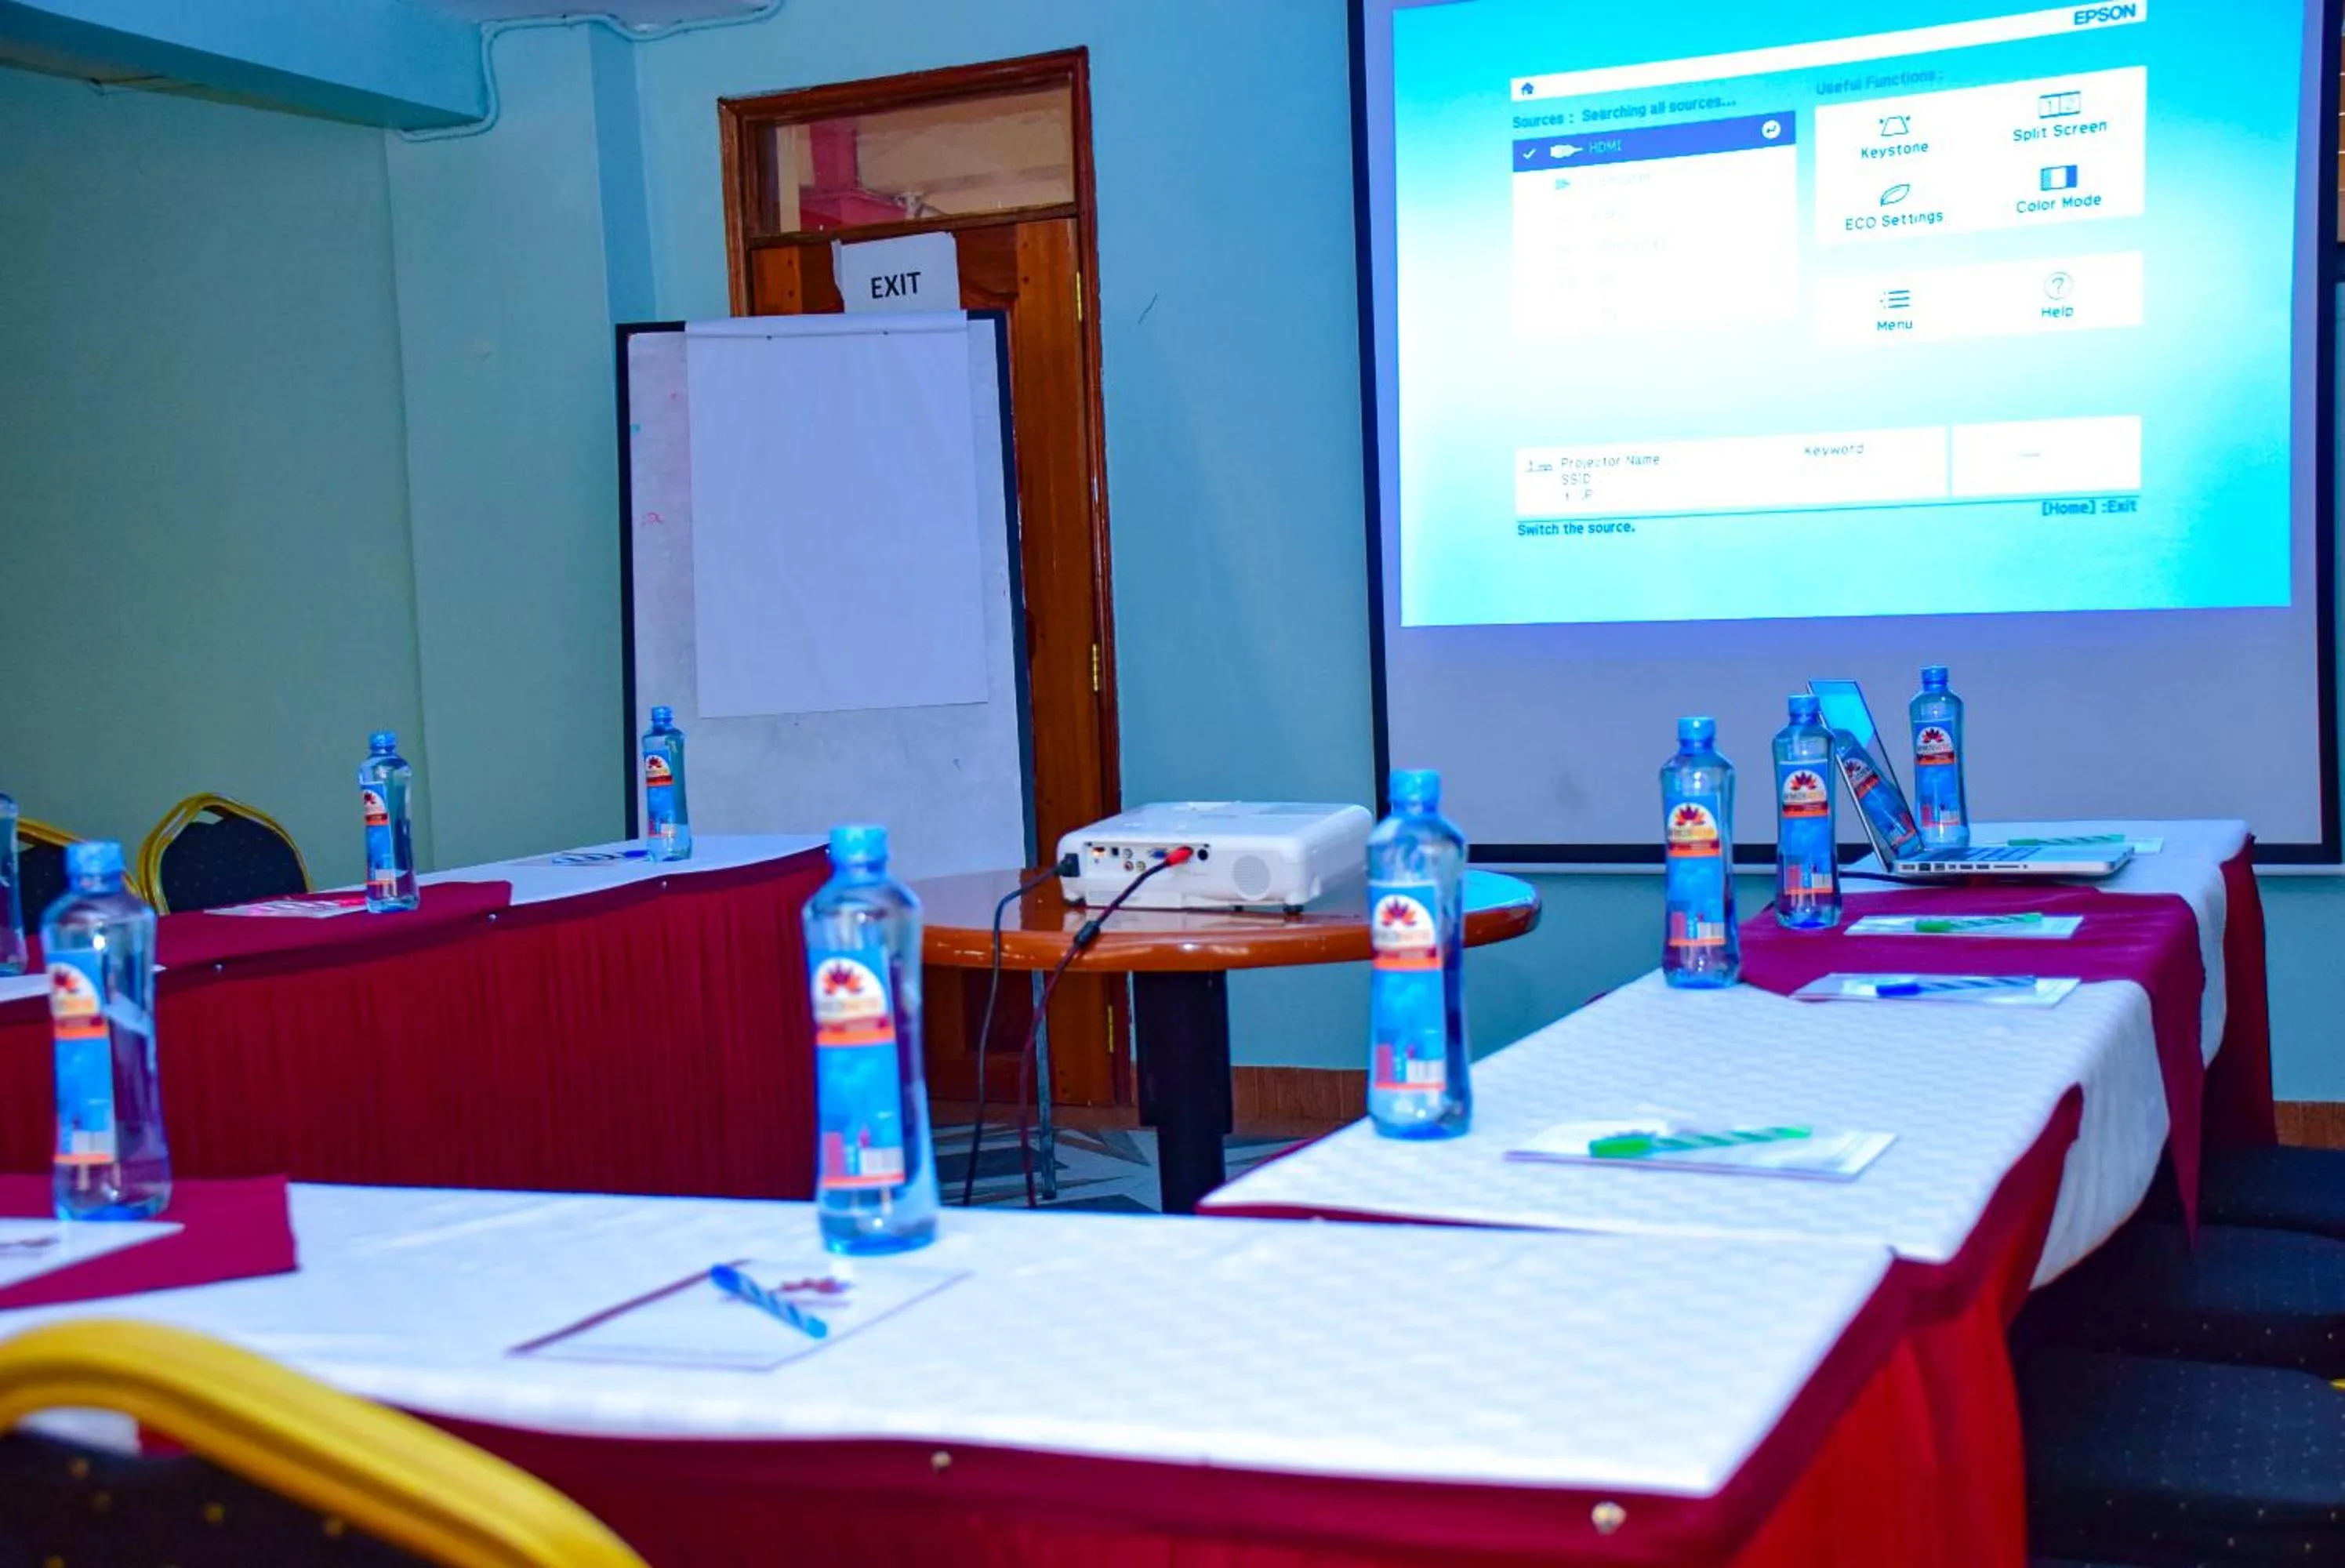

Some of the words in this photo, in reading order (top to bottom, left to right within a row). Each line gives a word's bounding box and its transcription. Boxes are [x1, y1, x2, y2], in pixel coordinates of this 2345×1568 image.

[2074, 4, 2136, 25] EPSON
[1816, 78, 1861, 95] Useful
[1512, 114, 1564, 129] Sources
[1582, 103, 1646, 122] Searching
[1650, 102, 1665, 115] all
[1668, 97, 1737, 114] sources...
[2013, 128, 2046, 142] Split
[2053, 122, 2107, 138] Screen
[1588, 140, 1622, 154] HDMI
[1860, 141, 1929, 160] Keystone
[2016, 200, 2056, 214] Color
[2062, 194, 2102, 209] Mode
[1846, 217, 1877, 230] ECO
[1882, 211, 1944, 228] Settings
[871, 272, 921, 299] EXIT
[2041, 306, 2075, 318] Help
[1877, 319, 1913, 331] Menu
[1517, 524, 1559, 536] Switch
[1564, 523, 1585, 535] the
[1588, 521, 1636, 535] source.
